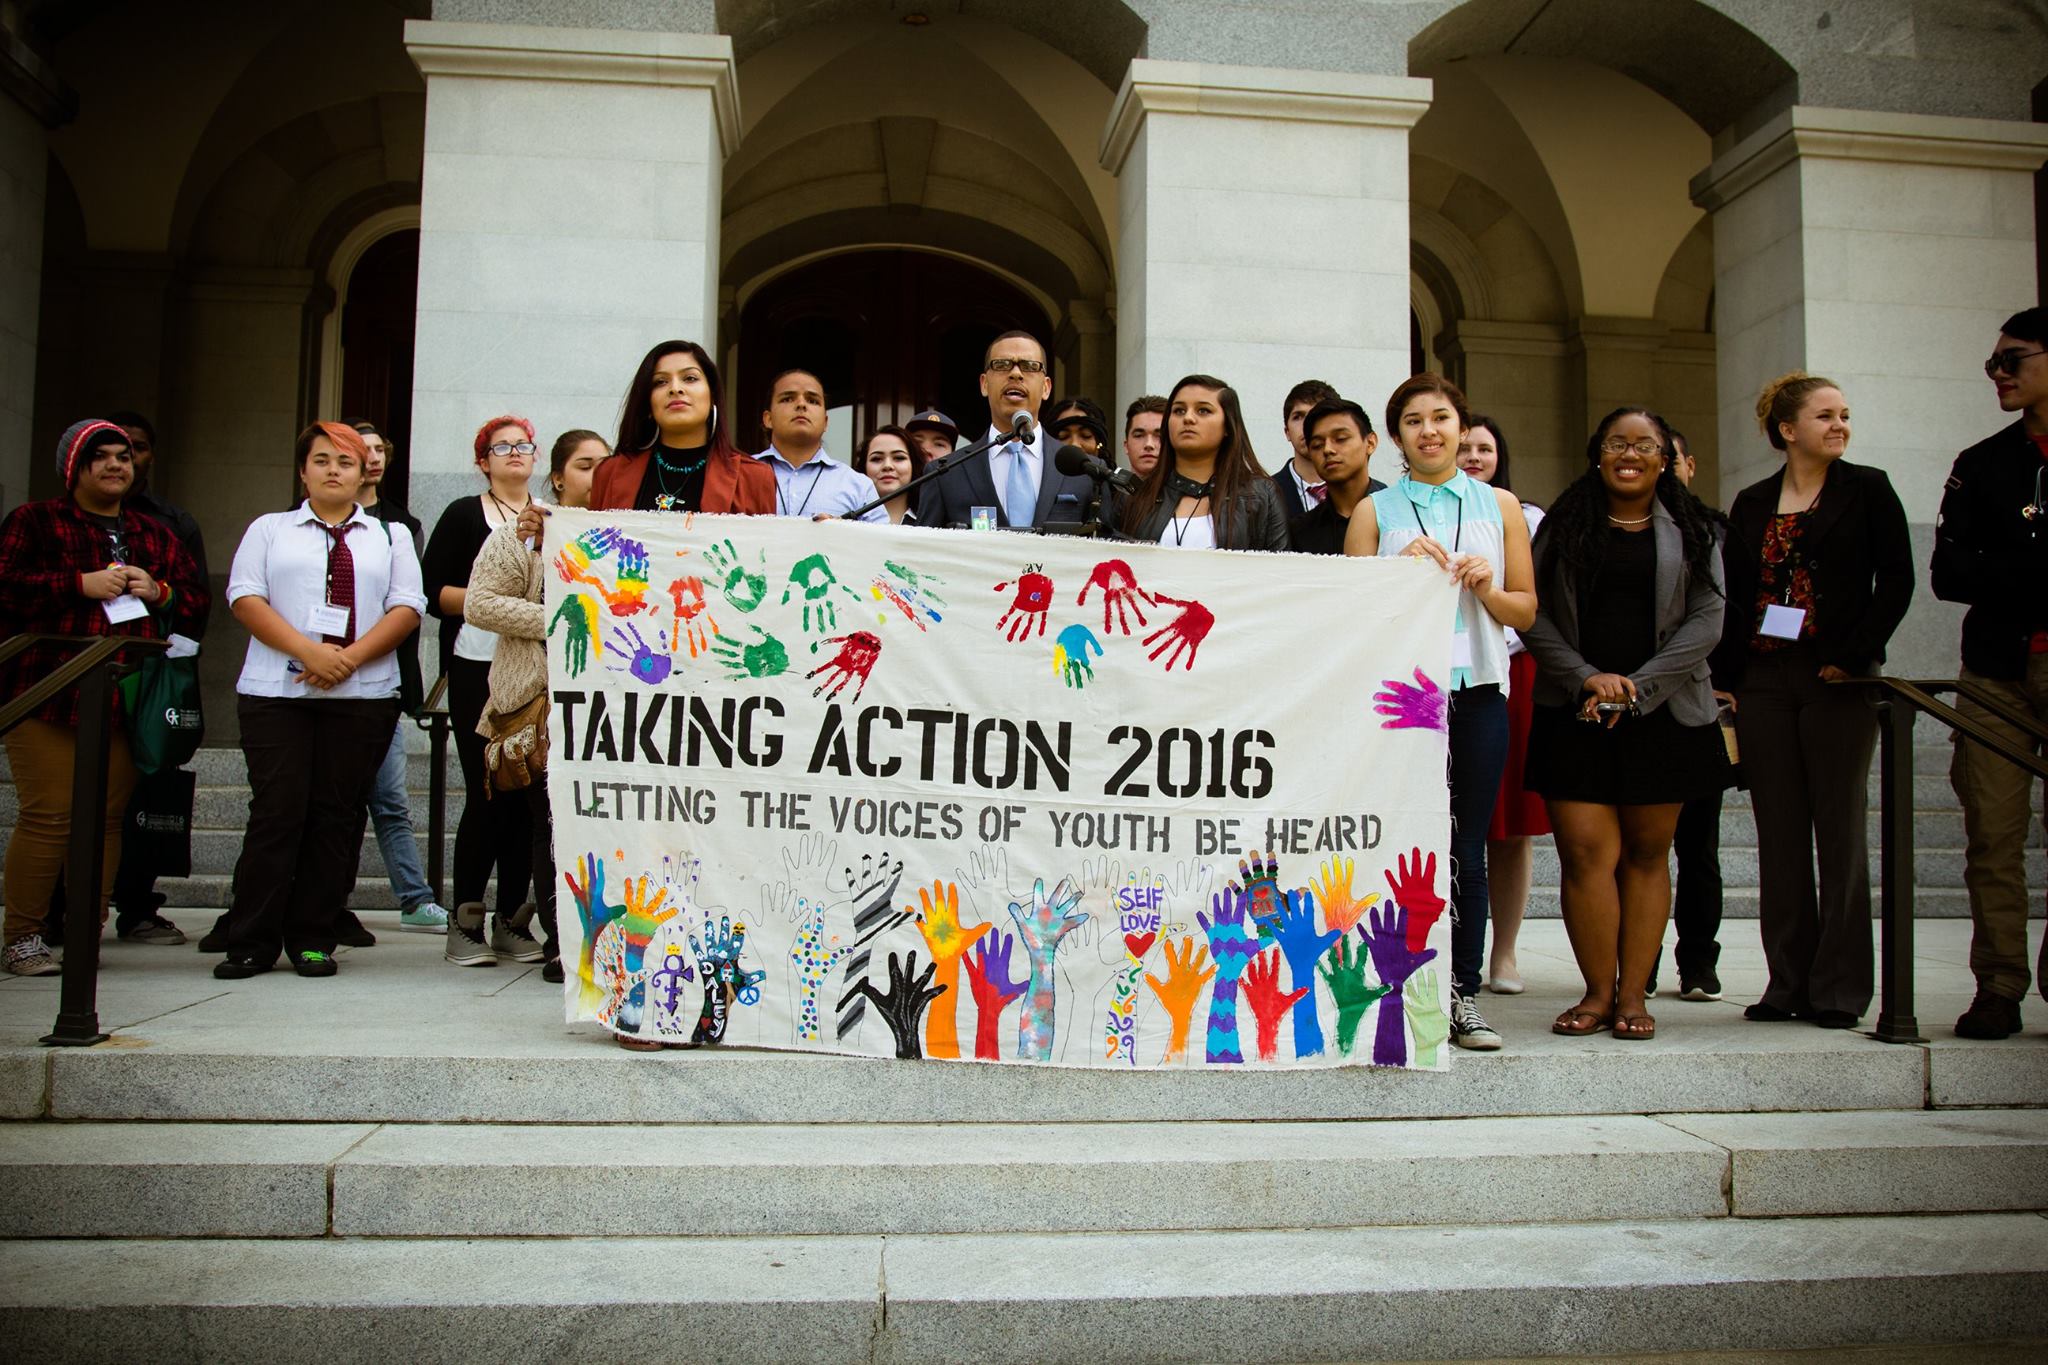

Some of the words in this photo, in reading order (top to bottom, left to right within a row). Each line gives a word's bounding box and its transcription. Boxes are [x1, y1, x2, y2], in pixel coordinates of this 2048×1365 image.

[553, 691, 785, 768] TAKING
[807, 704, 1072, 791] ACTION
[1104, 726, 1276, 799] 2016
[574, 781, 716, 825] LETTING
[740, 791, 811, 830] THE
[830, 796, 963, 841] VOICES
[979, 806, 1027, 842] OF
[1049, 811, 1170, 853] YOUTH
[1196, 819, 1242, 855] BE
[1266, 815, 1382, 854] HEARD
[1121, 913, 1161, 932] LOVE
